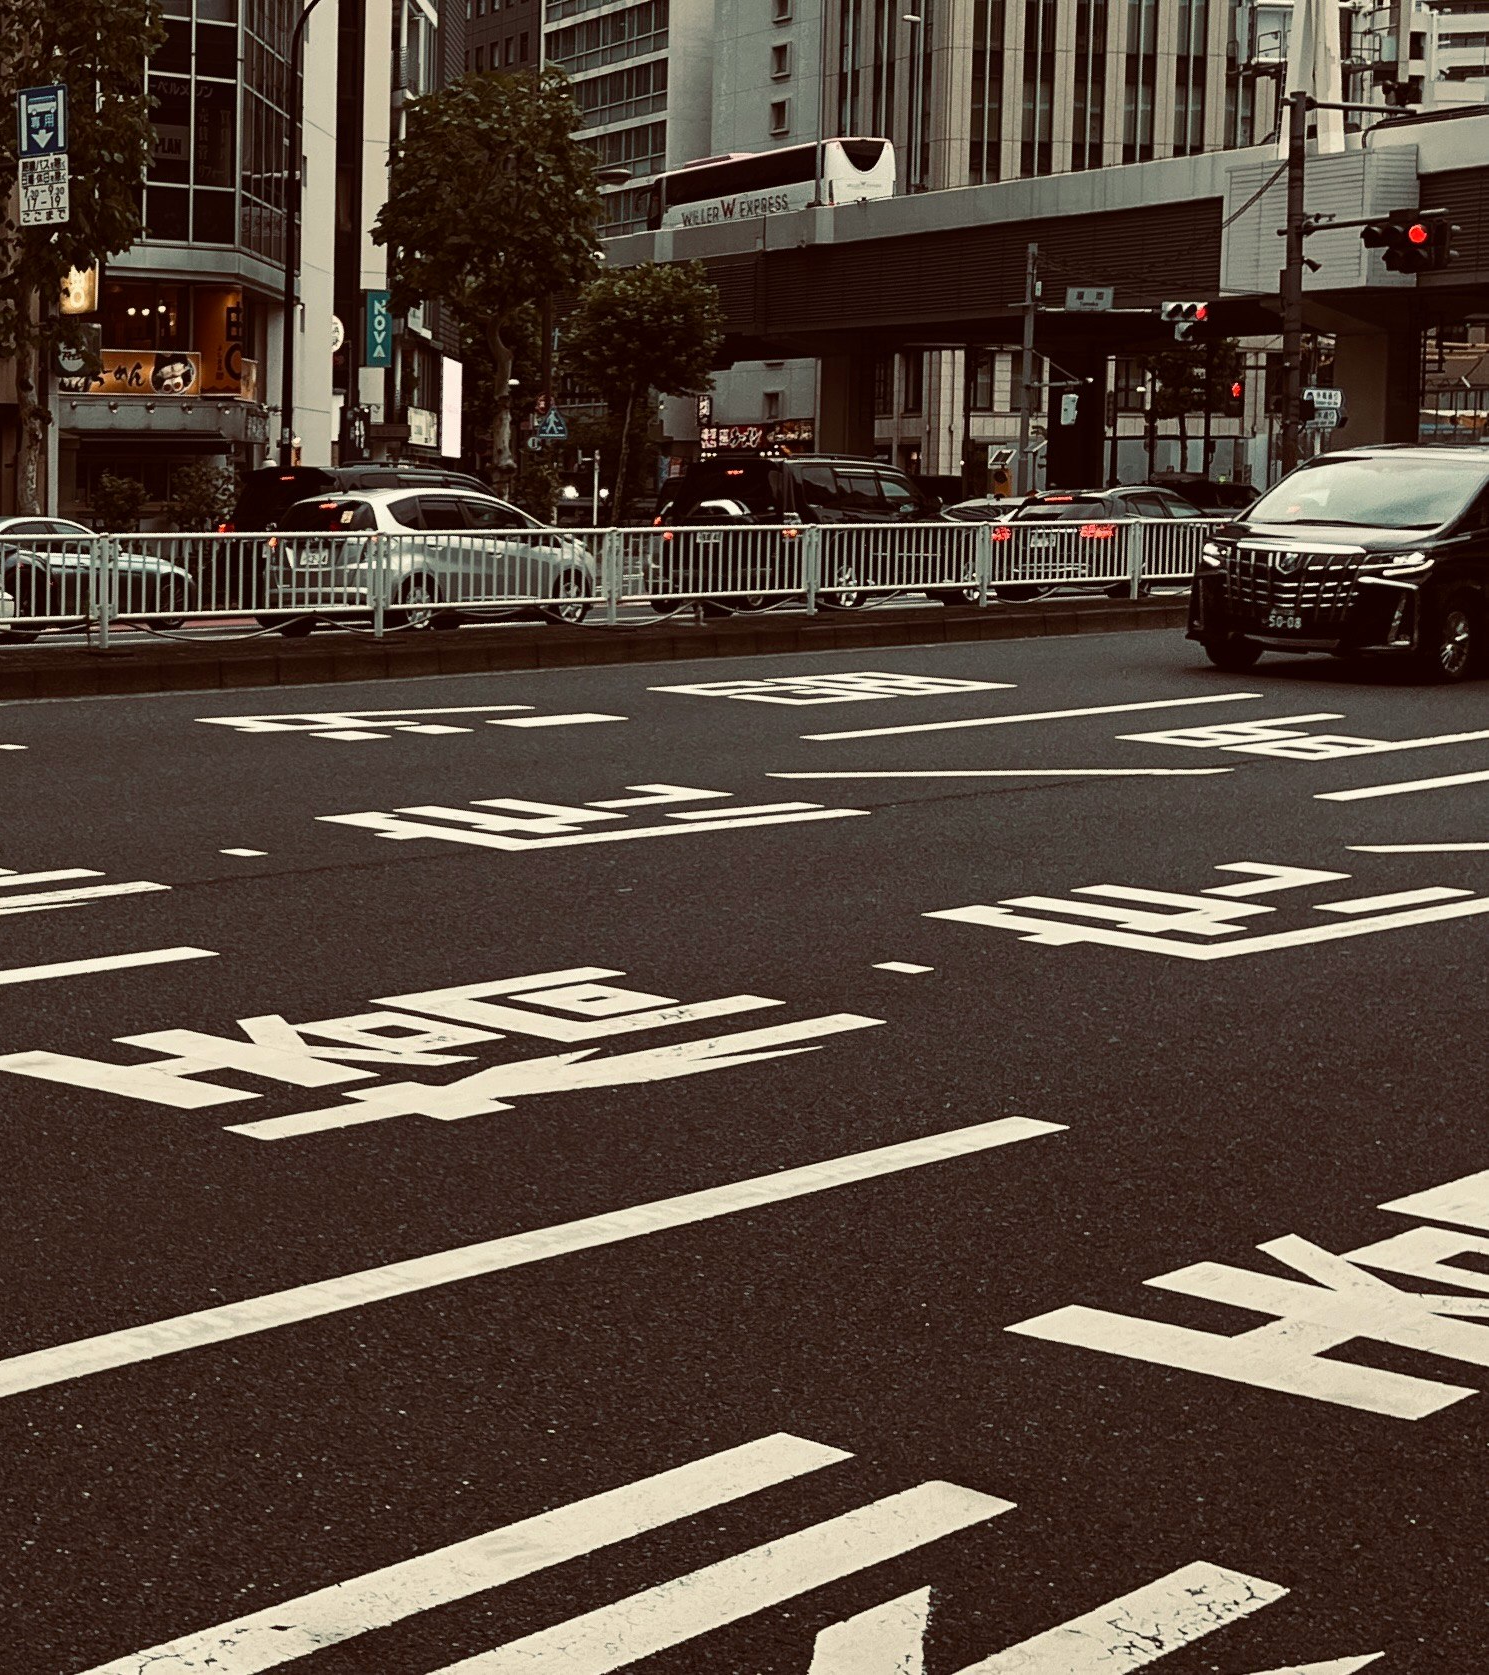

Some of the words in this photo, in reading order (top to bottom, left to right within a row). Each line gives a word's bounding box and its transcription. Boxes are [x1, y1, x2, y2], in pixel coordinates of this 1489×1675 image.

[22, 210, 66, 223] ここまで
[372, 299, 387, 358] NOVA
